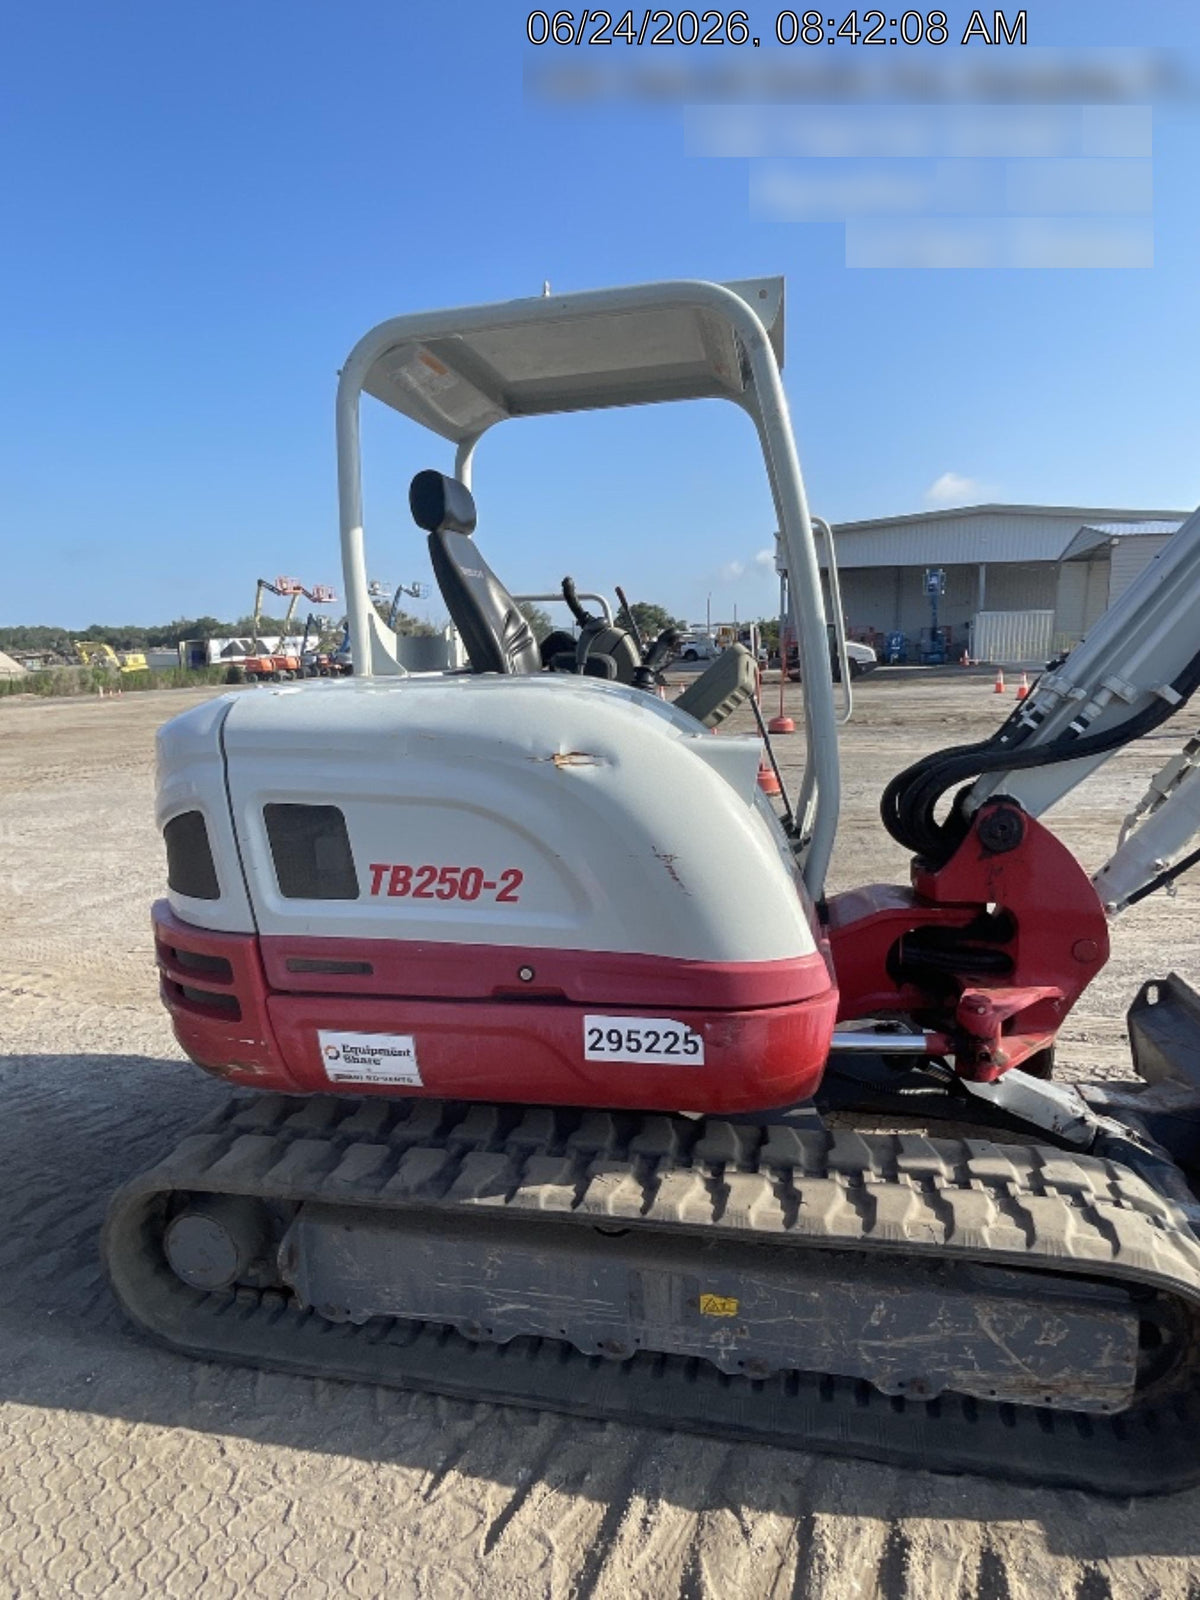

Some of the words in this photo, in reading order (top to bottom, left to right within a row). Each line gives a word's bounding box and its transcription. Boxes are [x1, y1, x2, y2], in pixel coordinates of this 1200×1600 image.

[369, 863, 524, 902] TB250-2
[341, 1044, 411, 1057] Equipment
[588, 1027, 700, 1055] 295225
[343, 1054, 382, 1066] Share
